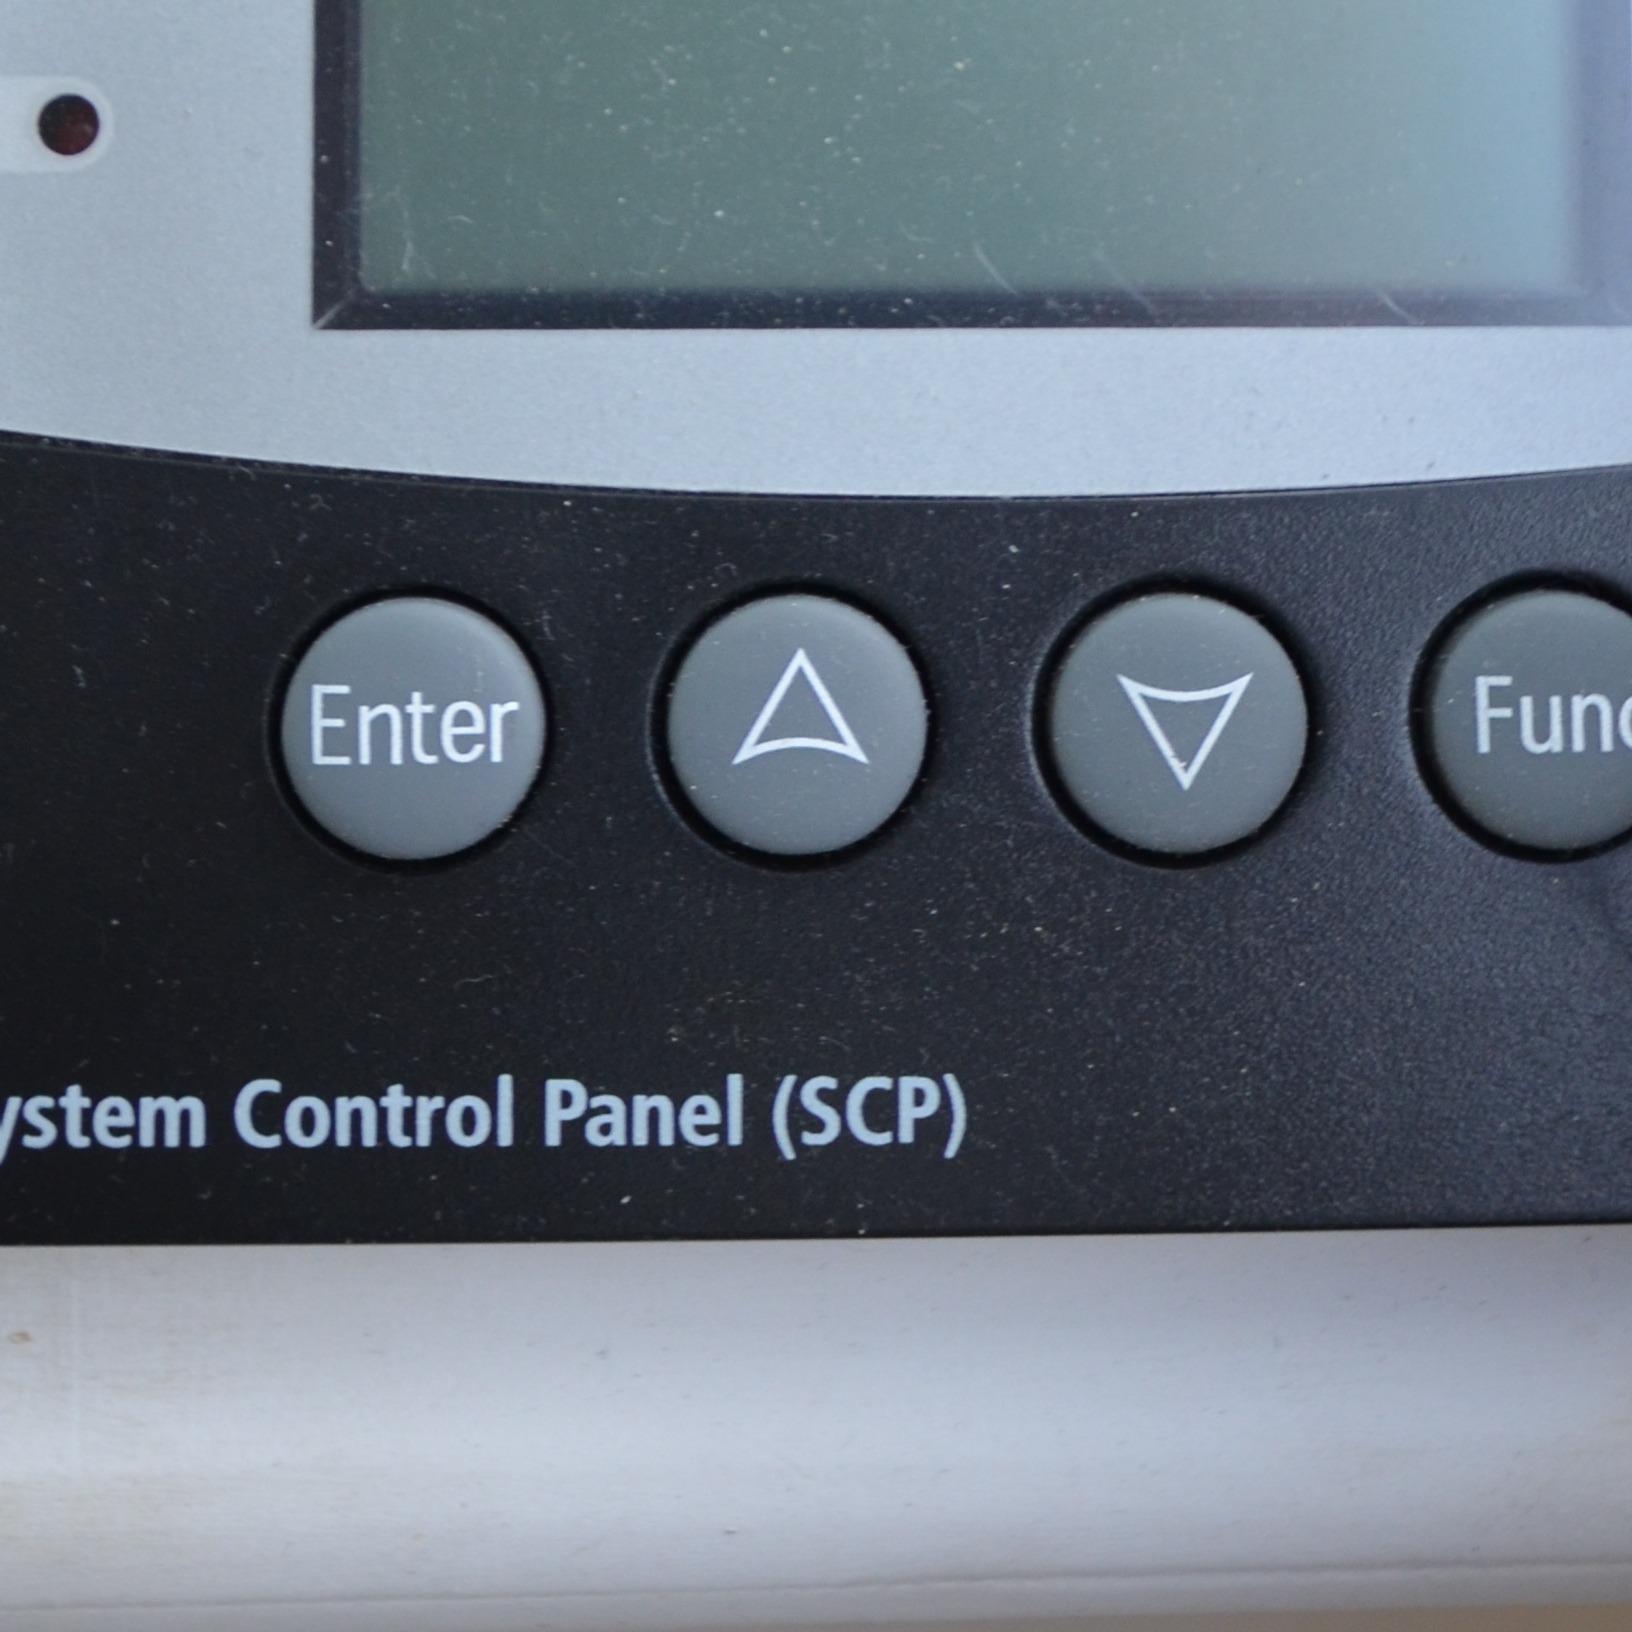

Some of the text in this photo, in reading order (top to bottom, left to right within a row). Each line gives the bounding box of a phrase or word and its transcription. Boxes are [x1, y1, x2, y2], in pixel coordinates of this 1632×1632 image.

[310, 682, 524, 767] Enter
[233, 1072, 514, 1149] Control
[544, 1072, 744, 1148] Panel
[771, 1072, 968, 1161] (SCP)
